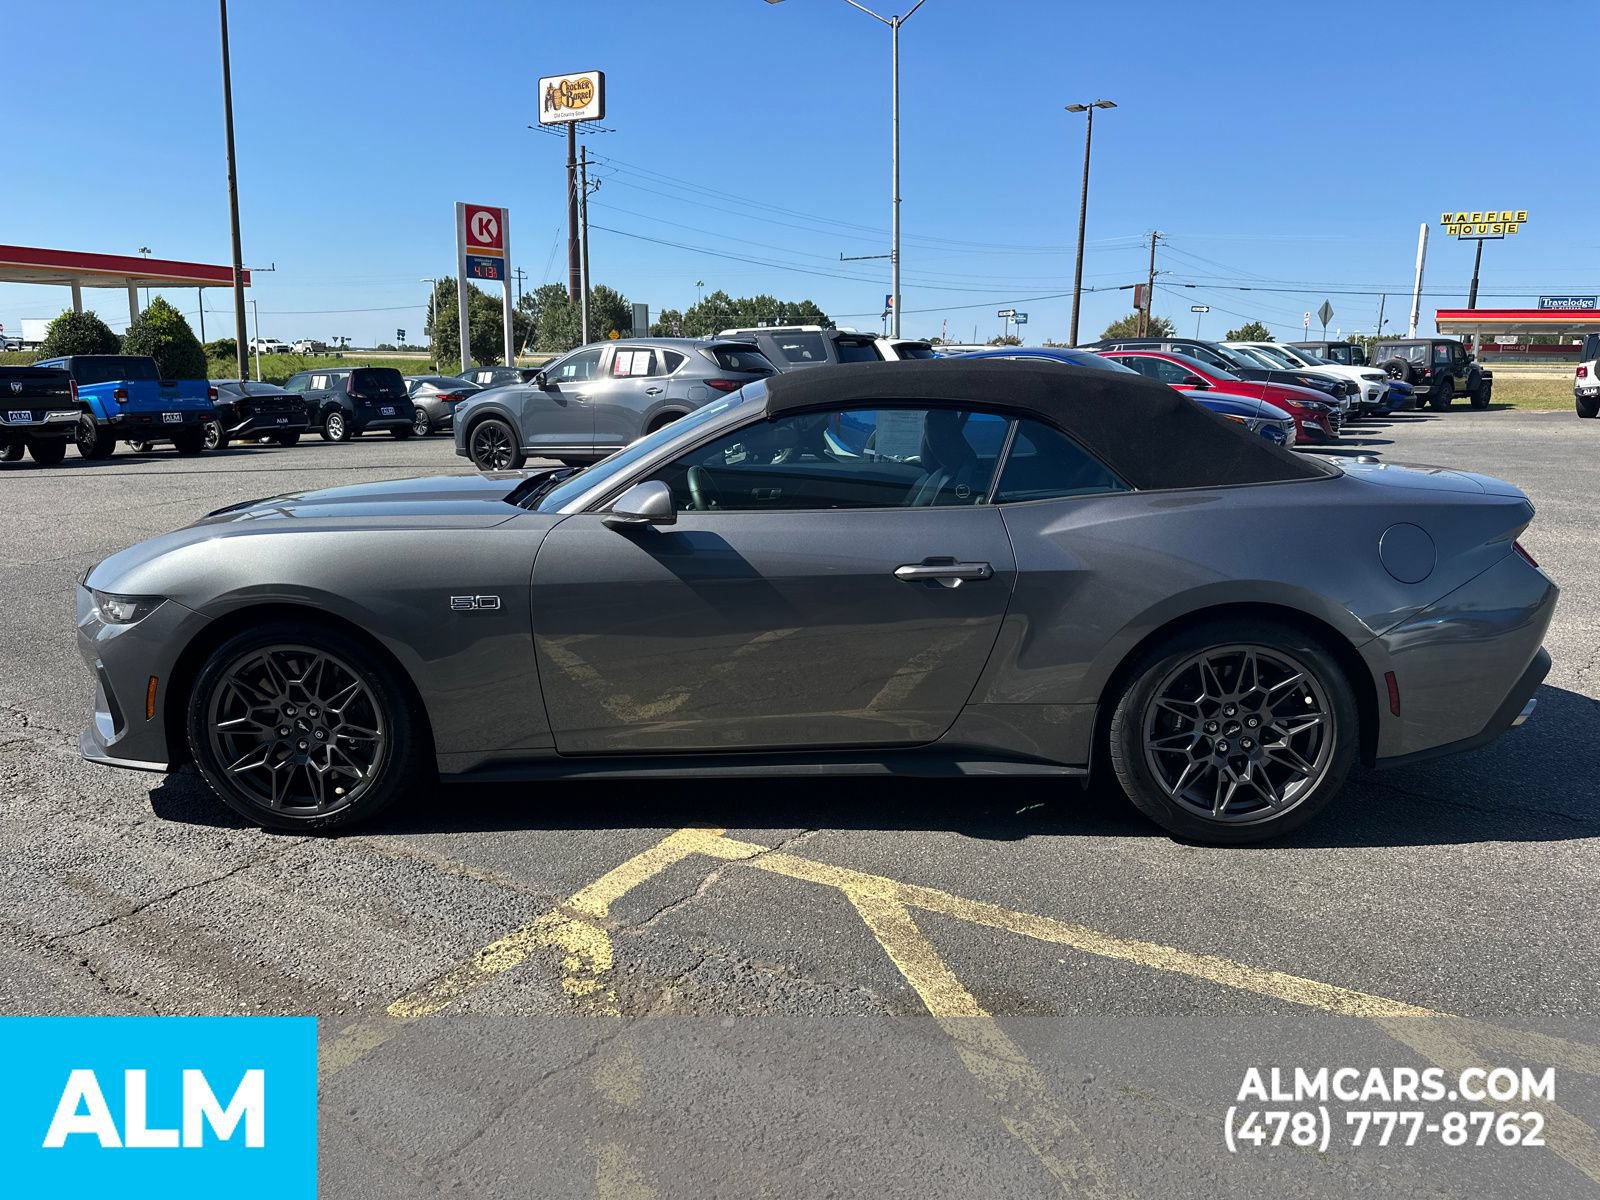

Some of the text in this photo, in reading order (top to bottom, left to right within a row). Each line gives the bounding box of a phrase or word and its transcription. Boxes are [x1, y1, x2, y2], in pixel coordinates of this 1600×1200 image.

[560, 80, 590, 96] Cracker
[566, 90, 591, 108] Barrel
[1443, 211, 1526, 223] WAFFLE
[1448, 224, 1516, 234] HOUSE
[1543, 298, 1593, 308] Travelodge
[451, 595, 500, 610] 5.0
